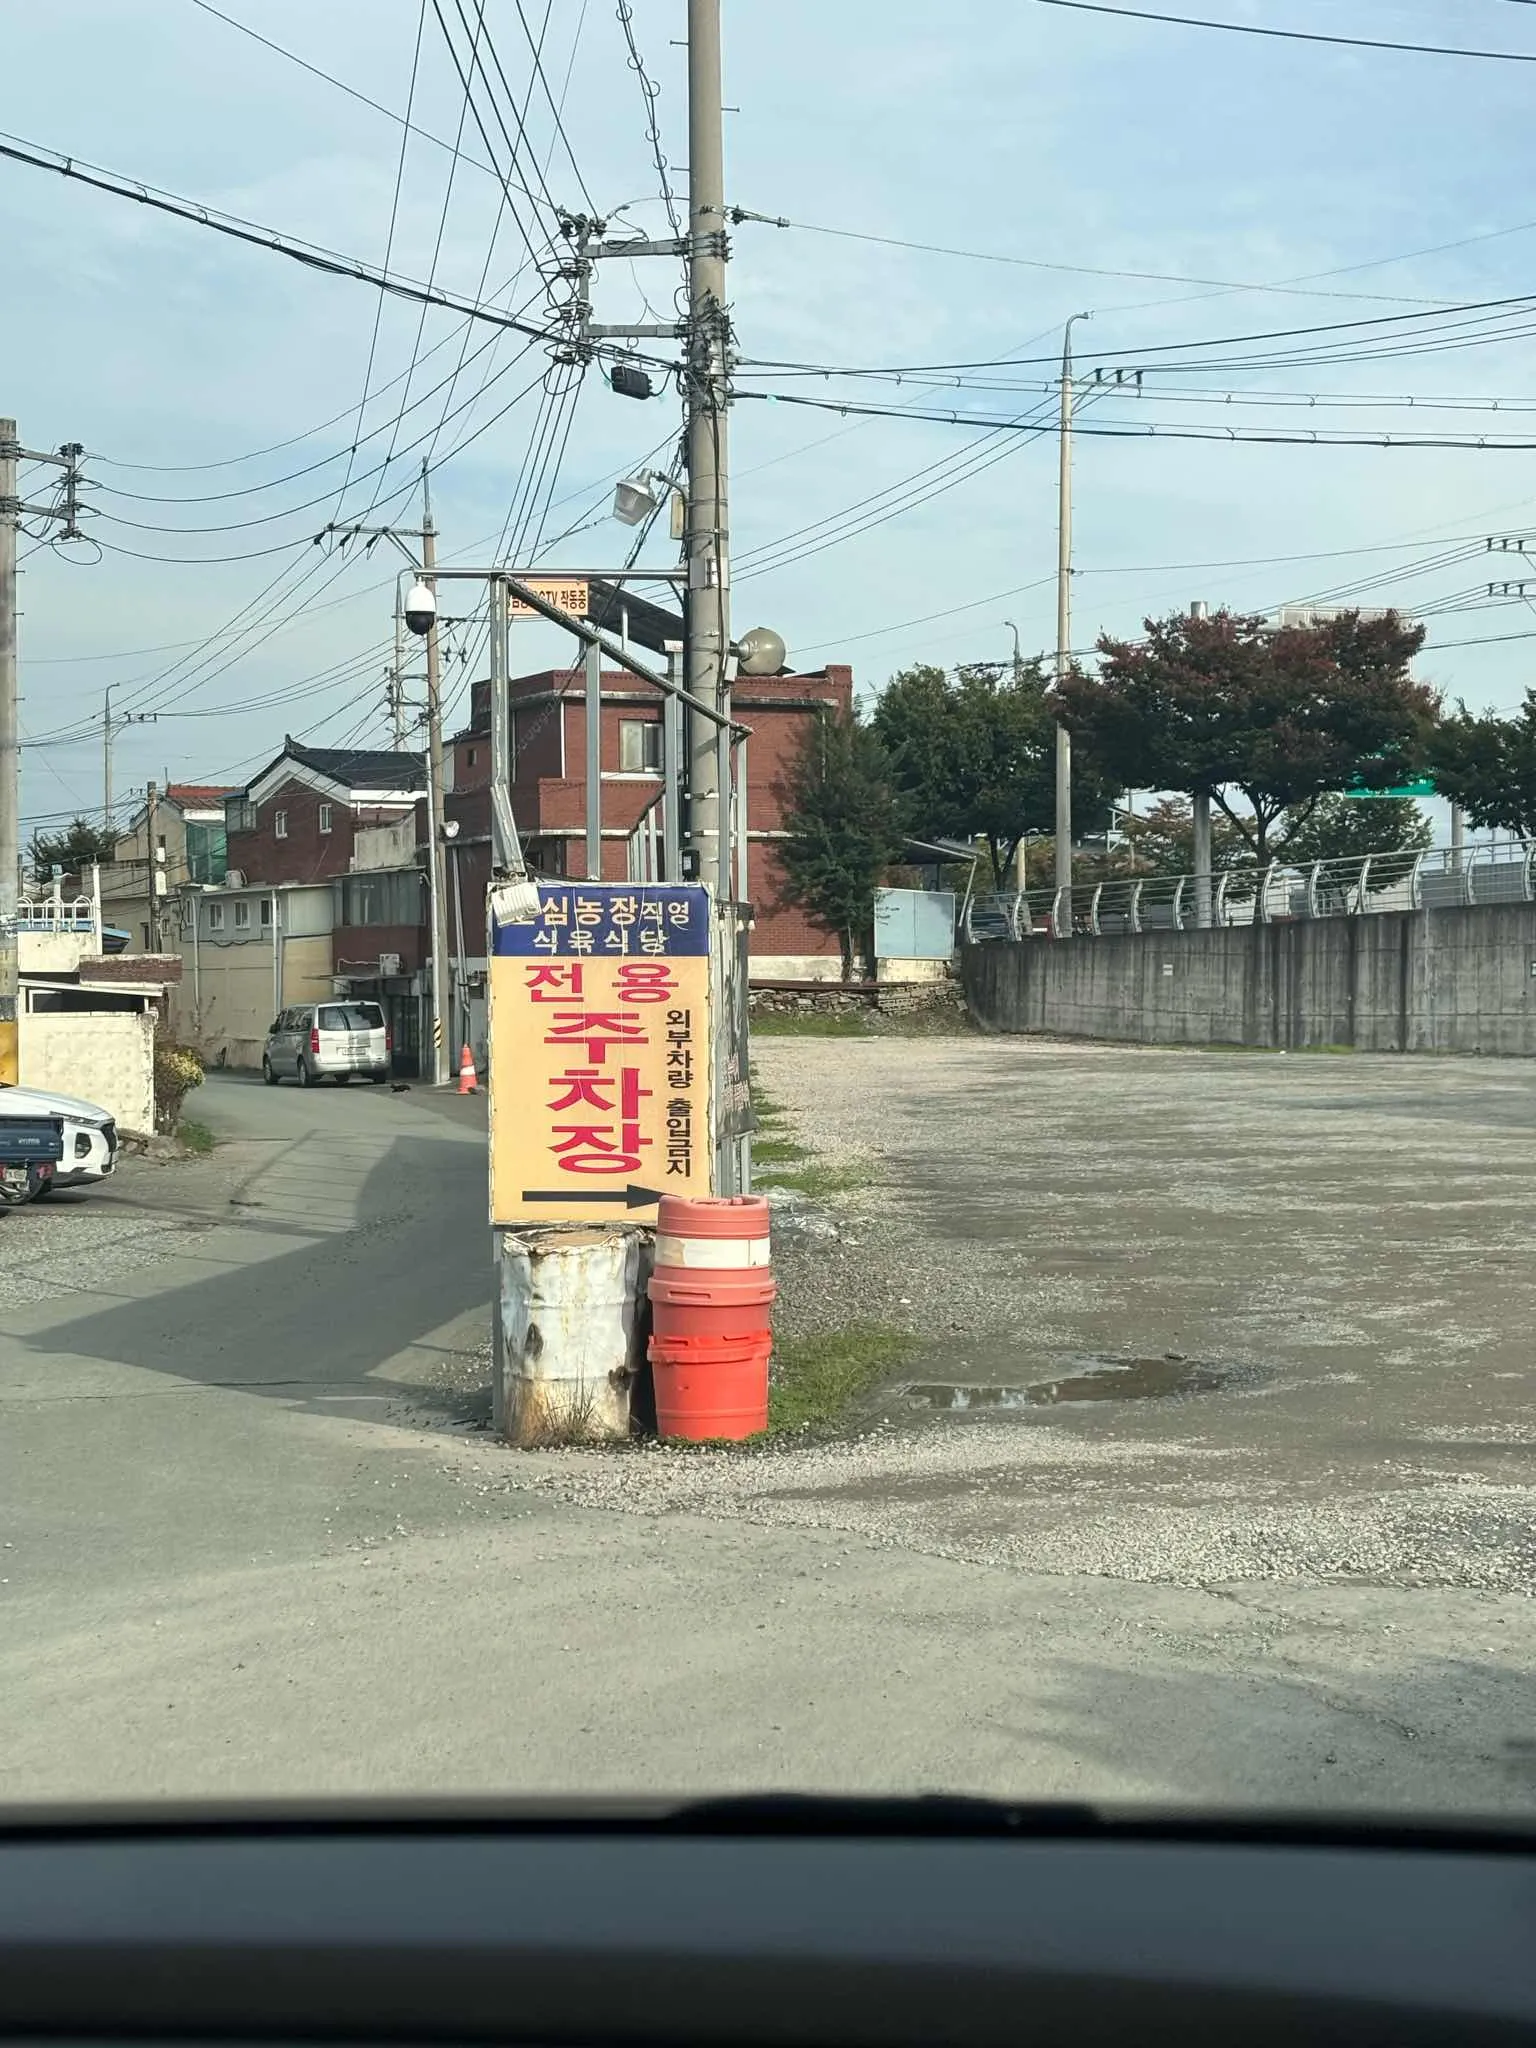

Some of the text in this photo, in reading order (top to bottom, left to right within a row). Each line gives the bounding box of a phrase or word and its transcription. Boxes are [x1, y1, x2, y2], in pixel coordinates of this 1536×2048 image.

[561, 590, 586, 610] 작동중
[532, 929, 669, 953] 식육식당
[525, 962, 679, 1003] 전용
[543, 1012, 653, 1174] 주차장
